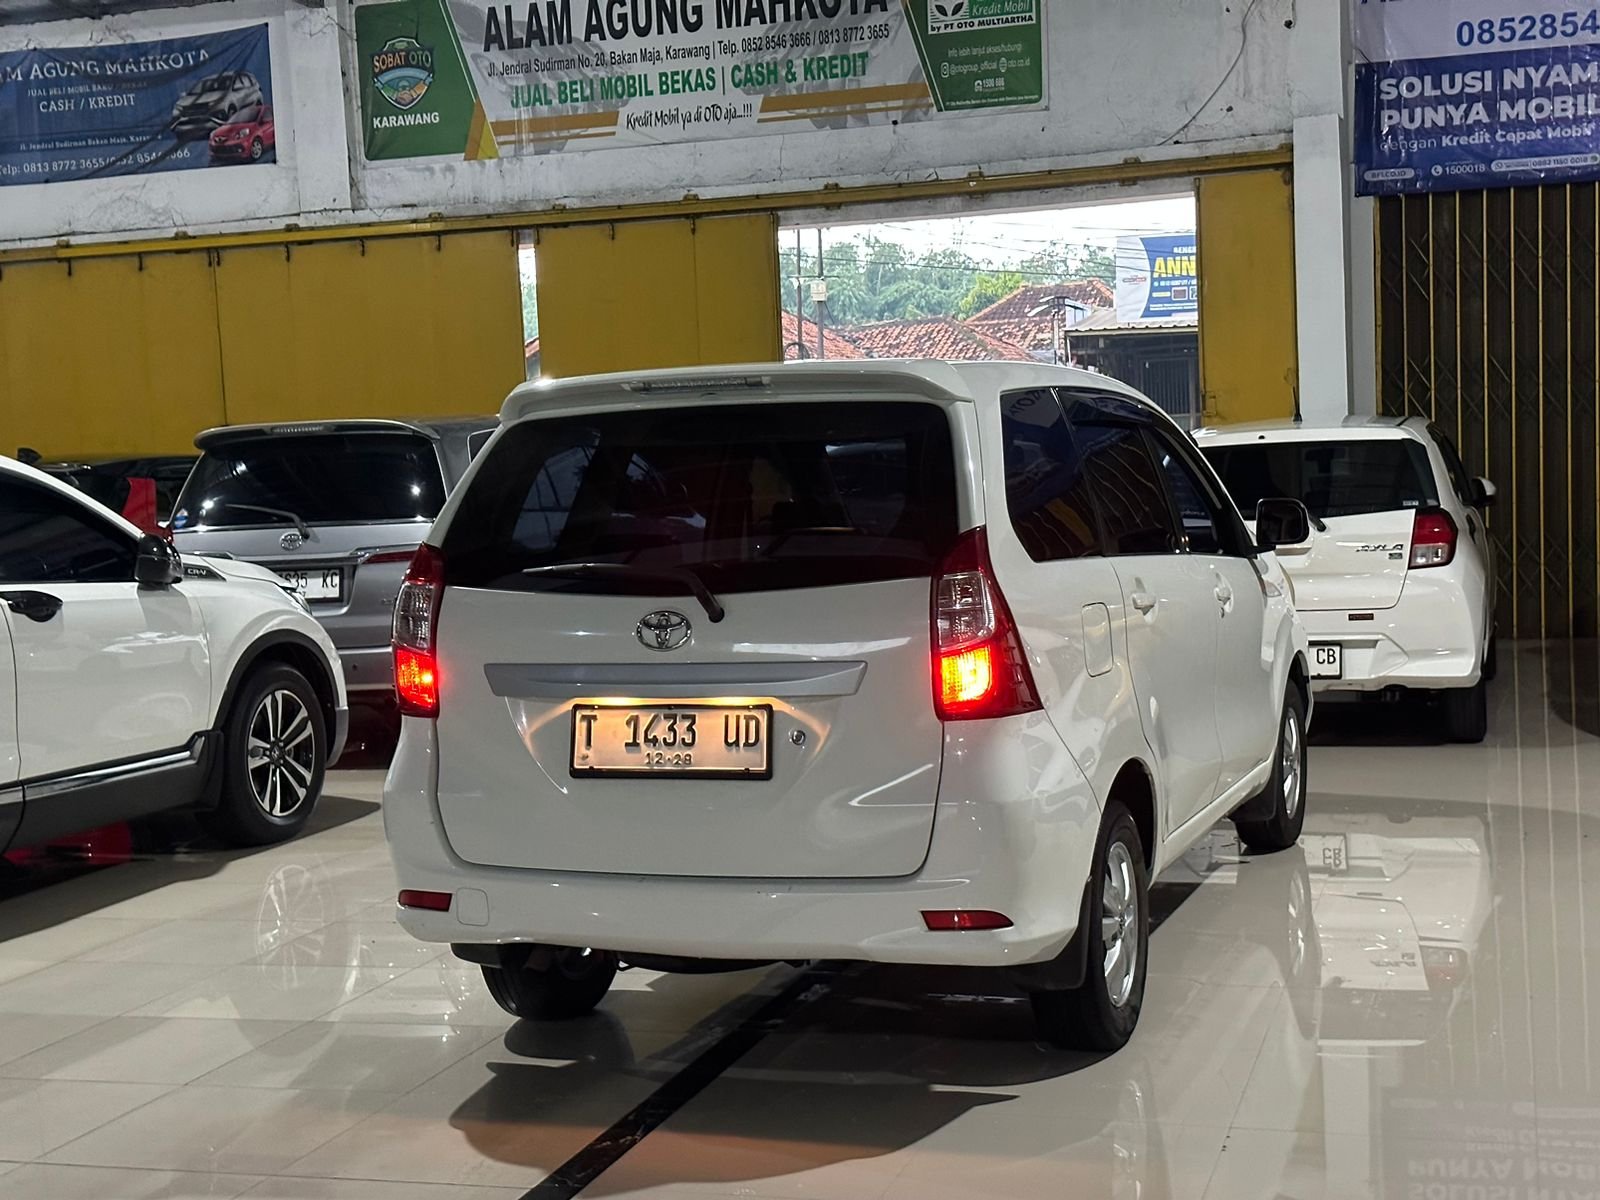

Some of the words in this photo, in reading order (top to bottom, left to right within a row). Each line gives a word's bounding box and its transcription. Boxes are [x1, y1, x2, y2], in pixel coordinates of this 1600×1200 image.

[972, 2, 1001, 16] Kredit
[1003, 0, 1030, 13] Mobil
[483, 2, 573, 52] ALAM
[584, 0, 703, 42] AGUNG
[716, 0, 888, 30] MAHK
[930, 24, 942, 32] by
[944, 22, 954, 31] PT
[957, 20, 975, 29] OTO
[977, 14, 1034, 27] MULTIARTHA
[1456, 9, 1600, 47] 0852854
[373, 51, 406, 74] SOBAT
[408, 49, 432, 68] OTO
[488, 61, 499, 77] Jl.
[500, 60, 532, 76] Jendral
[534, 56, 576, 73] Sudirman
[577, 53, 593, 69] No.
[594, 51, 608, 68] 20,
[609, 50, 638, 66] Bakan
[640, 47, 663, 65] Maja,
[665, 44, 710, 61] Karawang
[718, 40, 739, 58] Telp.
[741, 36, 763, 53] 0852
[765, 34, 787, 51] 8546
[789, 31, 811, 49] 3666
[818, 29, 840, 45] 0813
[842, 26, 865, 43] 8772
[867, 23, 890, 40] 3655
[29, 59, 100, 80] AGUNG
[105, 48, 209, 75] MAHKOTA
[512, 81, 553, 109] JUAL
[557, 79, 596, 104] BELI
[600, 74, 654, 101] MOBIL
[658, 66, 716, 95] BEKAS
[731, 60, 778, 88] CASH
[785, 59, 797, 84] &
[803, 51, 869, 81] KREDIT
[1380, 70, 1492, 100] SOLUSI
[39, 100, 75, 112] CASH
[88, 94, 136, 110] KREDIT
[1380, 102, 1490, 133] PUNYA
[1500, 93, 1600, 122] MOBIL
[373, 112, 440, 128] KARAWANG
[626, 111, 653, 131] Kredit
[654, 107, 680, 128] Mobil
[681, 111, 692, 131] ya
[693, 106, 702, 122] di
[704, 103, 722, 123] OTO
[29, 142, 55, 150] Jendral
[55, 139, 86, 148] Sudirman
[1380, 137, 1437, 152] dengan
[1441, 129, 1491, 147] Kredit
[23, 162, 49, 173] 0813
[52, 160, 77, 172] 8772
[1445, 164, 1486, 175] 1500018
[321, 571, 338, 589] KC
[1316, 648, 1337, 665] CB
[578, 713, 599, 750] T
[624, 713, 697, 749] 1433
[723, 713, 761, 749] UD
